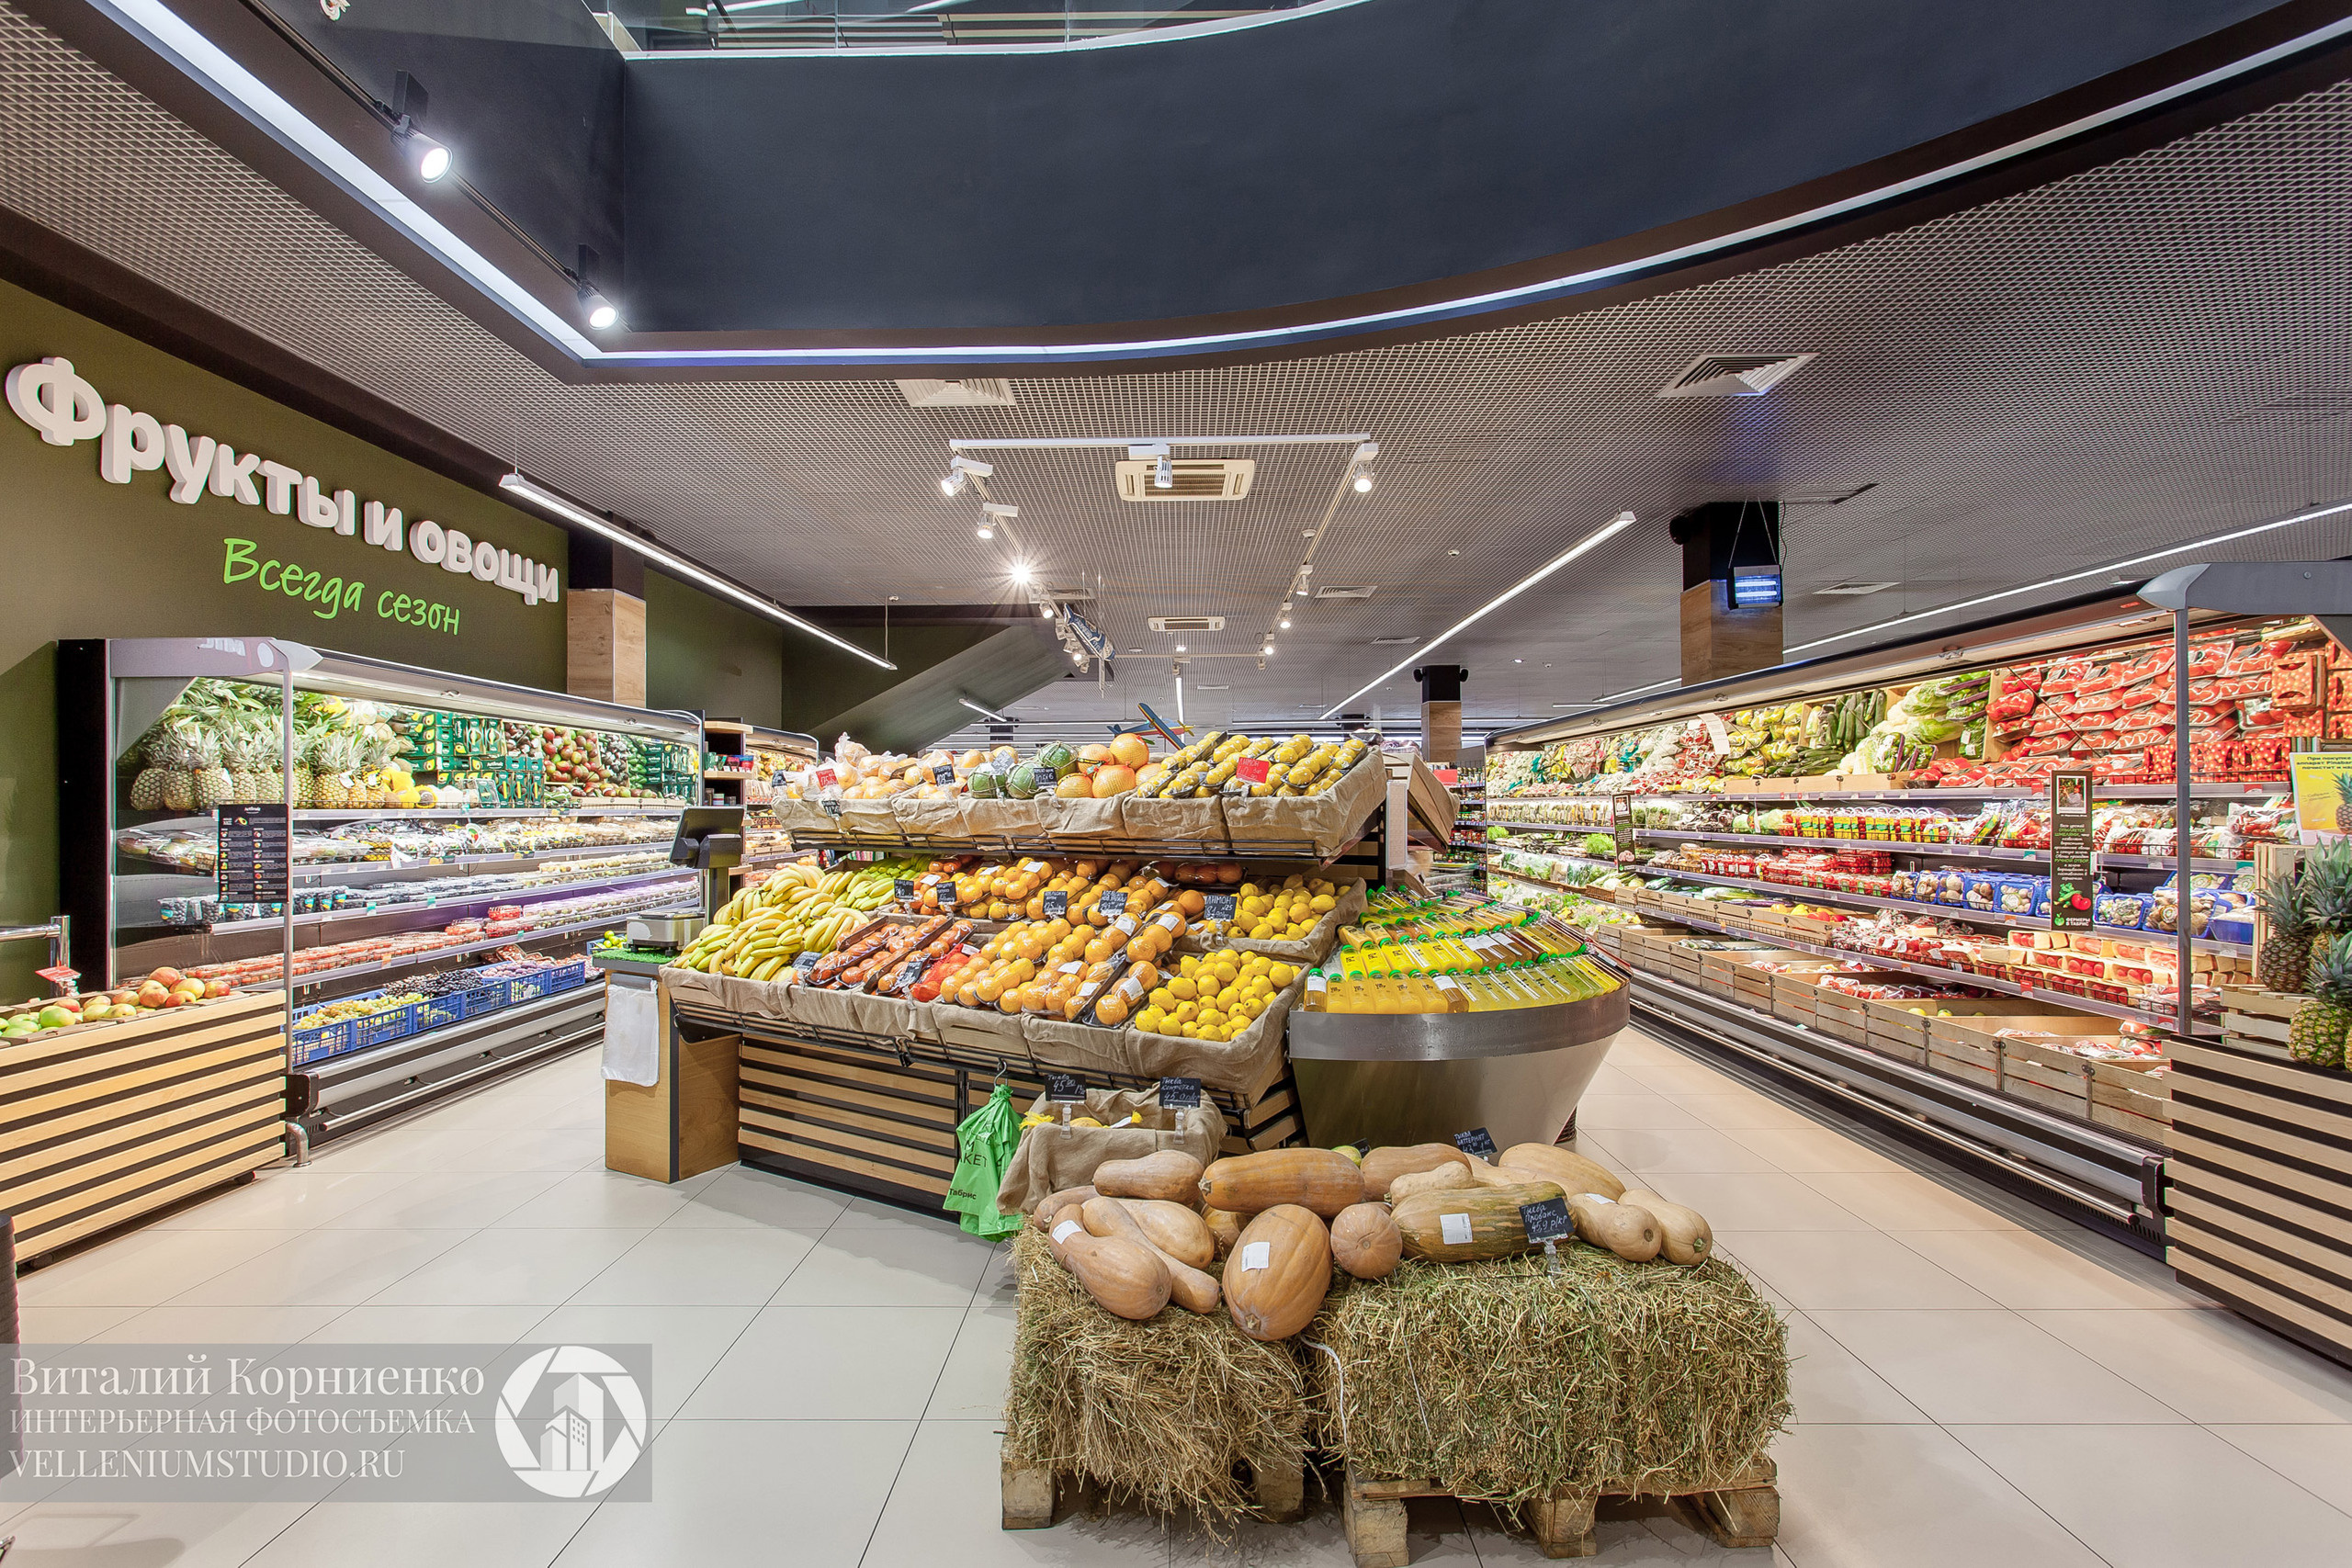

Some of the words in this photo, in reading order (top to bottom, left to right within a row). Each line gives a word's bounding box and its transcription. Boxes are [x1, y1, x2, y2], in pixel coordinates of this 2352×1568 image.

[6, 356, 356, 536] Фрукты
[364, 501, 403, 551] и
[410, 520, 560, 606] овощи
[222, 537, 366, 620] Всегда
[377, 589, 461, 637] сезон
